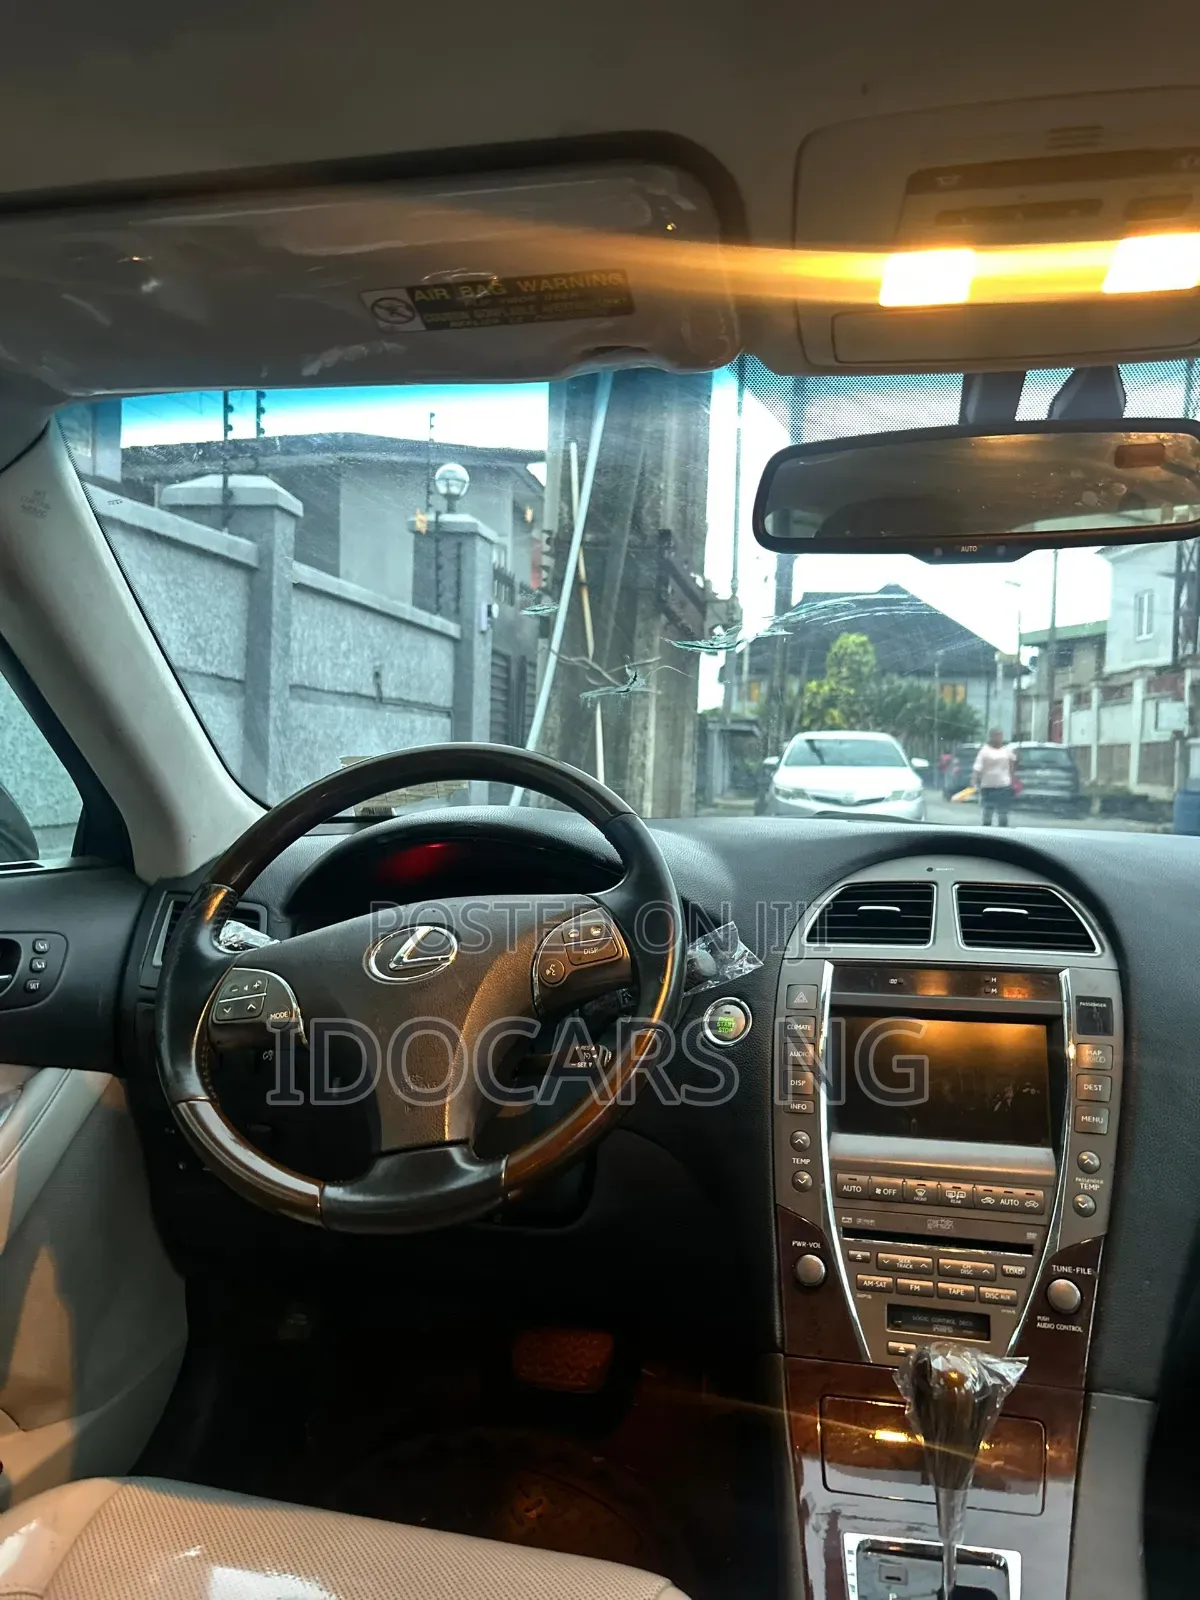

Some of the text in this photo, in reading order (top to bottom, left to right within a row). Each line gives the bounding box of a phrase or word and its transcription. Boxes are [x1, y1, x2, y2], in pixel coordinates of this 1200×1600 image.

[414, 288, 450, 302] AIR
[458, 282, 508, 299] BAG
[516, 272, 624, 293] WARNING
[583, 946, 599, 955] DISP
[29, 982, 40, 990] SET
[270, 1010, 289, 1020] MODE
[1083, 1083, 1103, 1092] DEST
[1081, 1115, 1104, 1124] MENU
[792, 1157, 811, 1165] TEMP
[842, 1185, 862, 1193] AUTO
[1080, 1182, 1100, 1191] TEMP
[883, 1188, 897, 1196] OFF
[1000, 1198, 1020, 1207] AUTO
[1005, 1268, 1024, 1276] LOAD
[909, 1284, 921, 1292] FM
[948, 1288, 965, 1296] TAPE
[1036, 1322, 1083, 1333] AUDIO CONTROL
